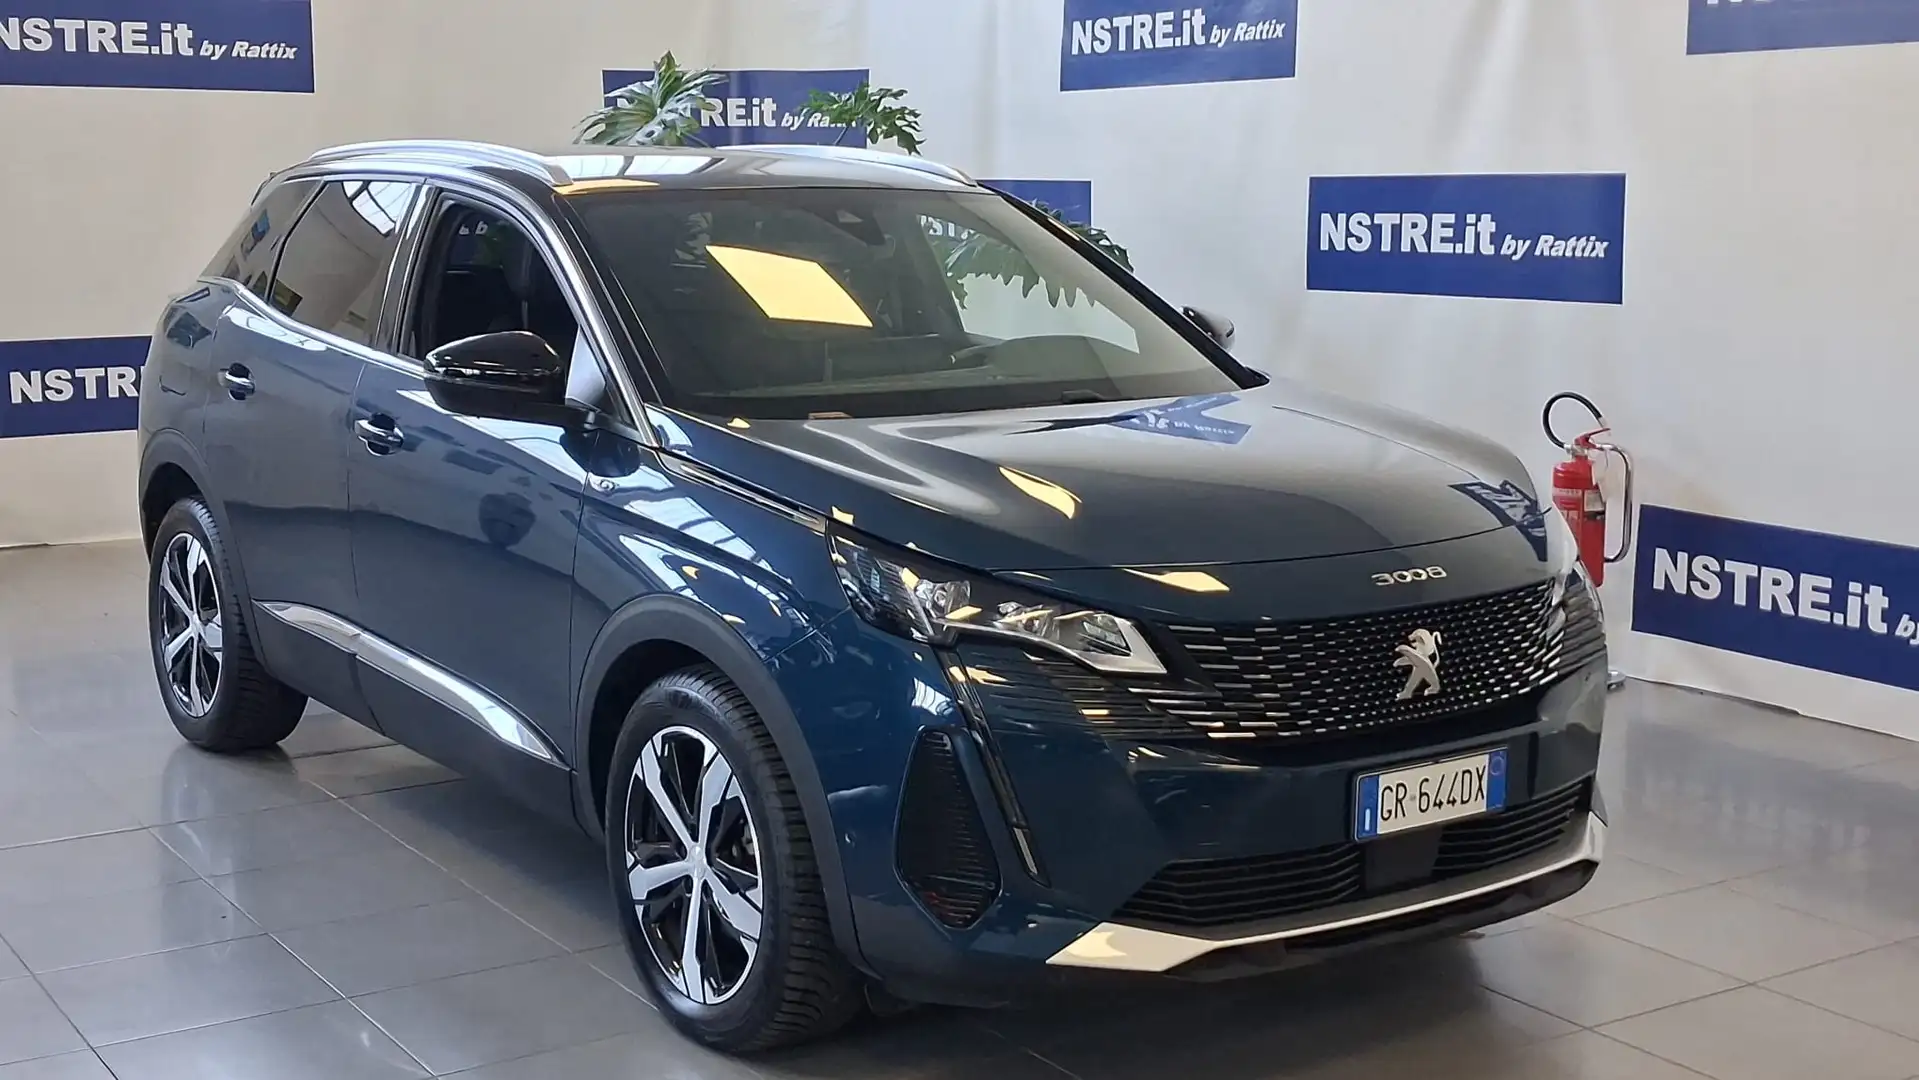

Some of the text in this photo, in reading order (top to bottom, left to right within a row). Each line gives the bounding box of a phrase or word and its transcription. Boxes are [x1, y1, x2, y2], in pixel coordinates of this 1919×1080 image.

[0, 17, 298, 60] NSTRE.it by Rattix
[1071, 8, 1286, 56] NSTRE.it by Rattix
[781, 112, 805, 131] by
[1320, 212, 1610, 261] NSTRE.it by Rattix
[9, 366, 146, 404] NSTR
[1371, 566, 1448, 586] 3008
[1653, 547, 1919, 645] NSTRE.it b
[1380, 781, 1408, 821] GR
[1418, 763, 1487, 814] 644DX
